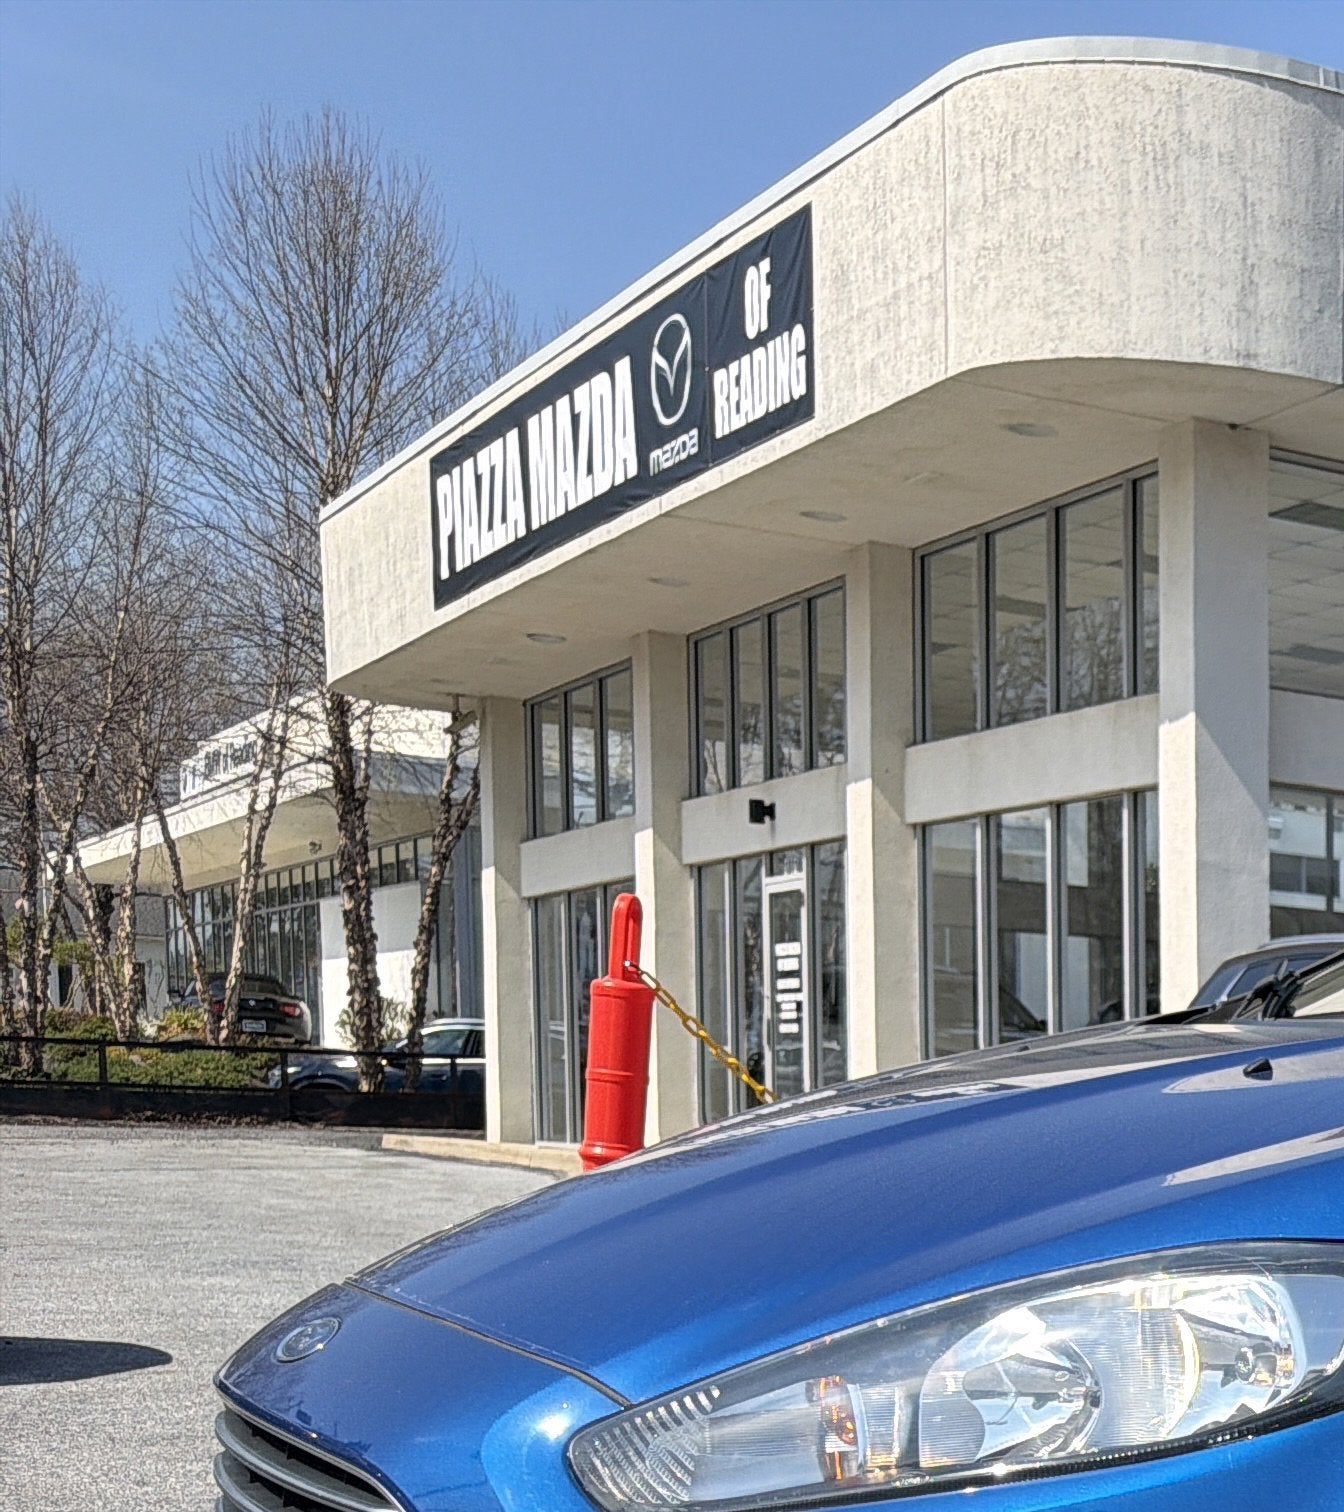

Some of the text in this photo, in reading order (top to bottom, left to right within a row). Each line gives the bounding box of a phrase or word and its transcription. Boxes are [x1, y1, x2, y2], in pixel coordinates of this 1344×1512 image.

[744, 256, 771, 340] OF
[713, 323, 807, 440] READING
[436, 355, 639, 581] PIAZZA MAZDA
[649, 427, 699, 477] mazda
